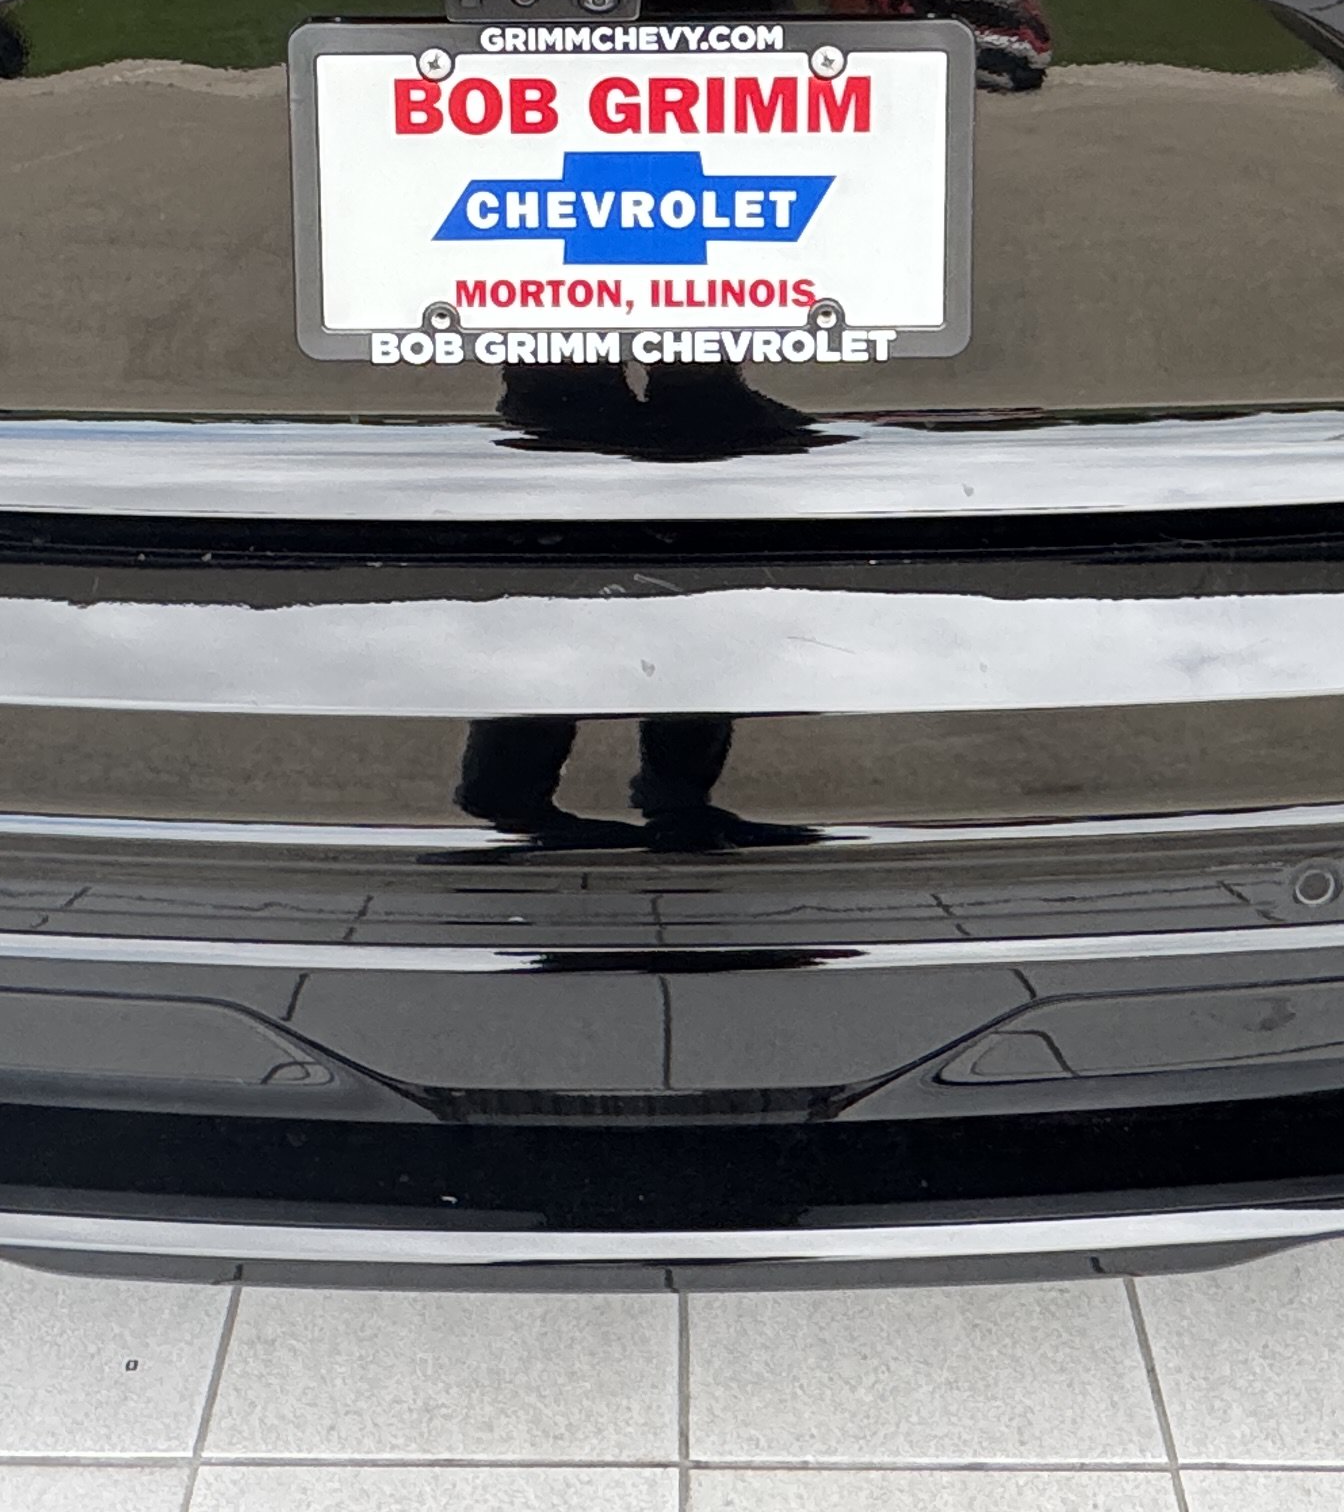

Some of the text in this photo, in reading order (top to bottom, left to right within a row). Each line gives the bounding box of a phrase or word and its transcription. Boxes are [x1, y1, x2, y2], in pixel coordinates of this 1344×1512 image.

[480, 25, 784, 52] GRIMMCHEVY.COM
[393, 76, 872, 135] BOB GRIMM
[465, 189, 798, 230] CHEVROLET
[455, 279, 816, 314] MORTON, ILLINOIS
[371, 329, 898, 365] BOB GRIMM CHEVROLET
